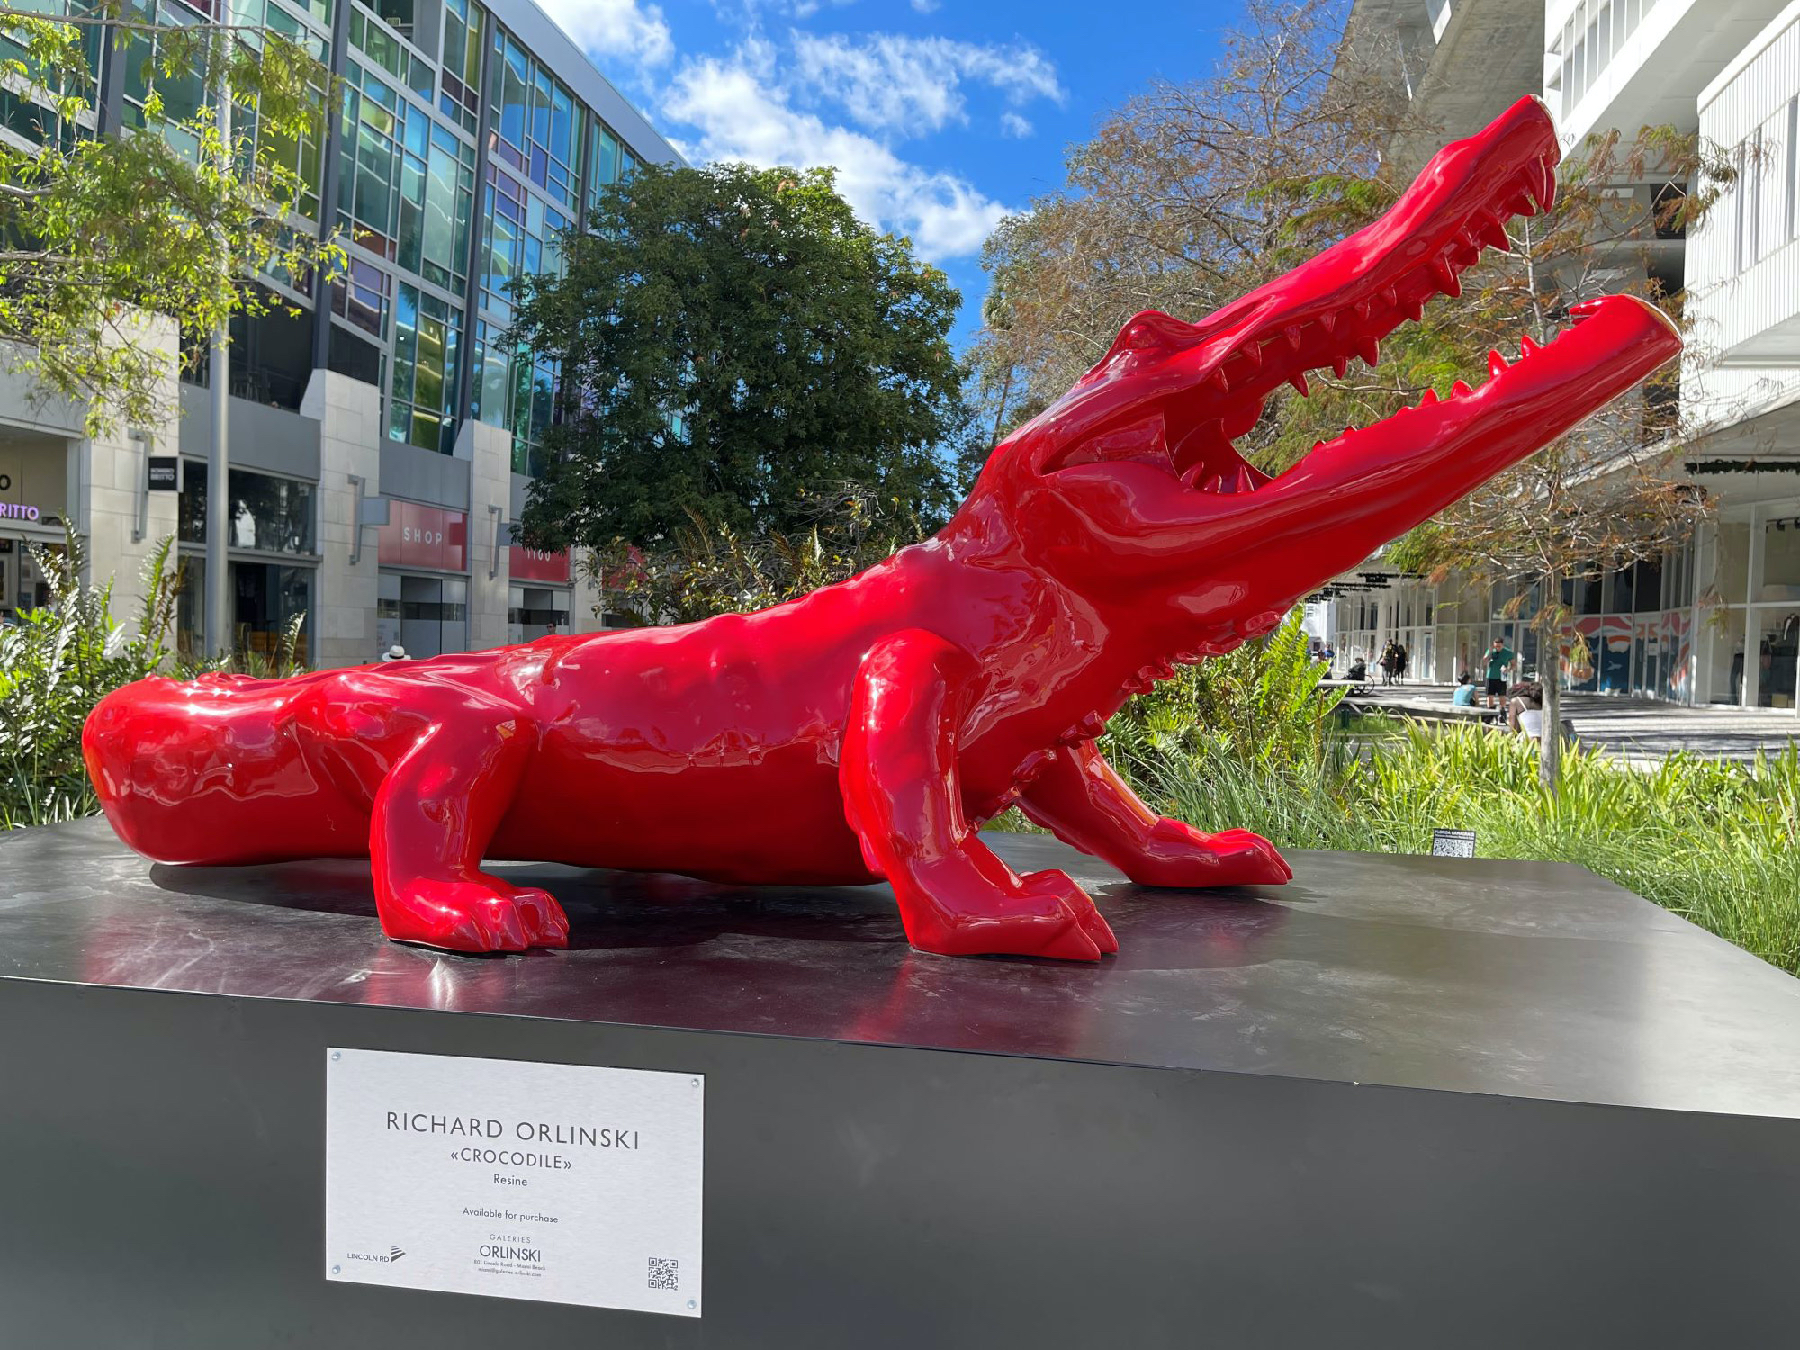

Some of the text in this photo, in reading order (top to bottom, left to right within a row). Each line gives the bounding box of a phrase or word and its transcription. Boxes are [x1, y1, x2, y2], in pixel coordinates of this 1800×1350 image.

[403, 527, 442, 545] SHOP
[387, 1111, 638, 1149] RICHARD ORLINSKI
[450, 1147, 572, 1169] «CROCODILE»
[493, 1173, 528, 1186] Resine
[462, 1207, 559, 1223] Available for purchase
[489, 1233, 531, 1244] GALERIES
[346, 1253, 378, 1262] LINCOLN
[479, 1244, 541, 1262] ORLINSKI
